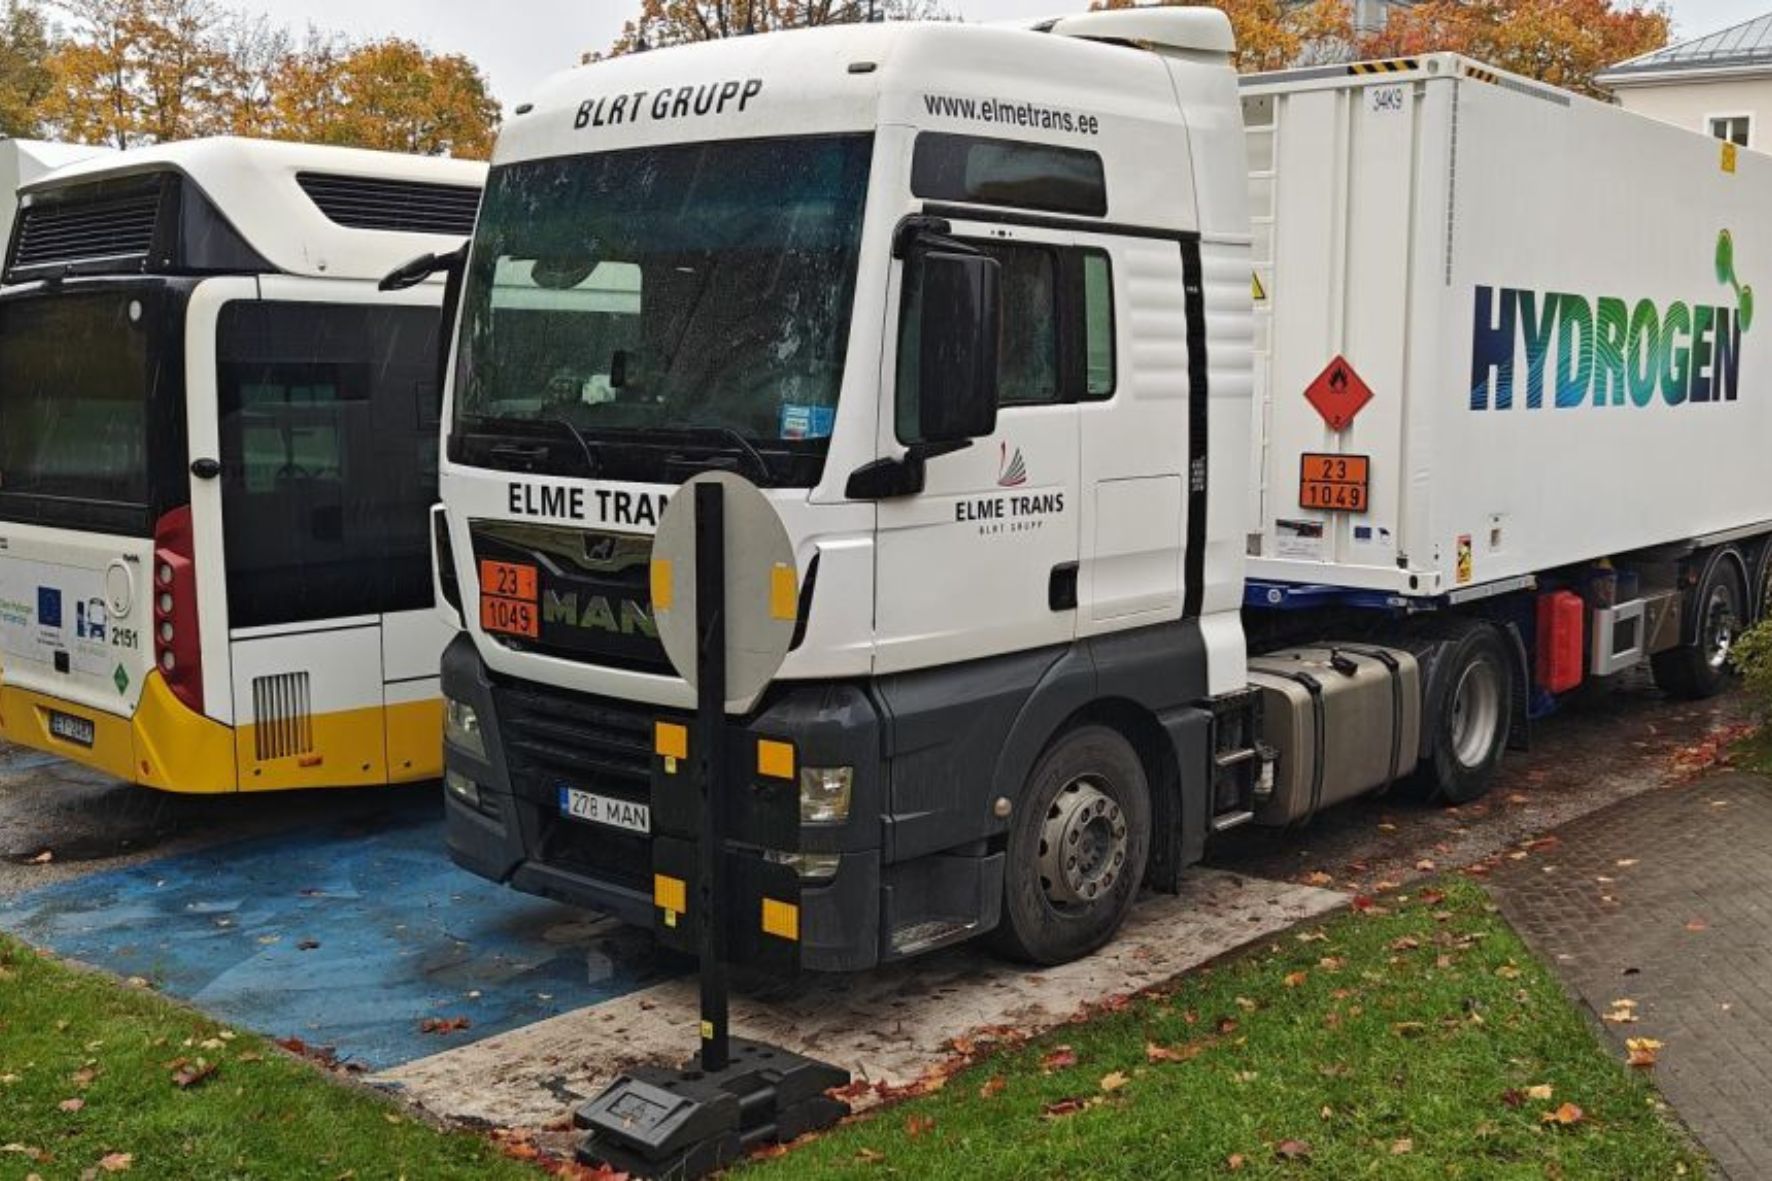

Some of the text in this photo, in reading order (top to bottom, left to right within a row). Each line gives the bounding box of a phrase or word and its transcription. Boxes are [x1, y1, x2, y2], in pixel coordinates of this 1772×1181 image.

[574, 78, 762, 129] BLRT GRUPP
[924, 94, 1098, 135] www.elmetrans.ee
[1373, 88, 1403, 111] 34K9
[1470, 285, 1742, 411] HYDROGEN
[1321, 459, 1347, 479] 23
[509, 482, 584, 519] ELME
[955, 493, 1064, 521] ELME TRANS
[1309, 486, 1360, 506] 1049
[497, 568, 518, 594] 23
[489, 602, 530, 632] 1049
[543, 589, 658, 638] MAN
[112, 626, 138, 649] 2151
[573, 792, 646, 828] 278 MAN
